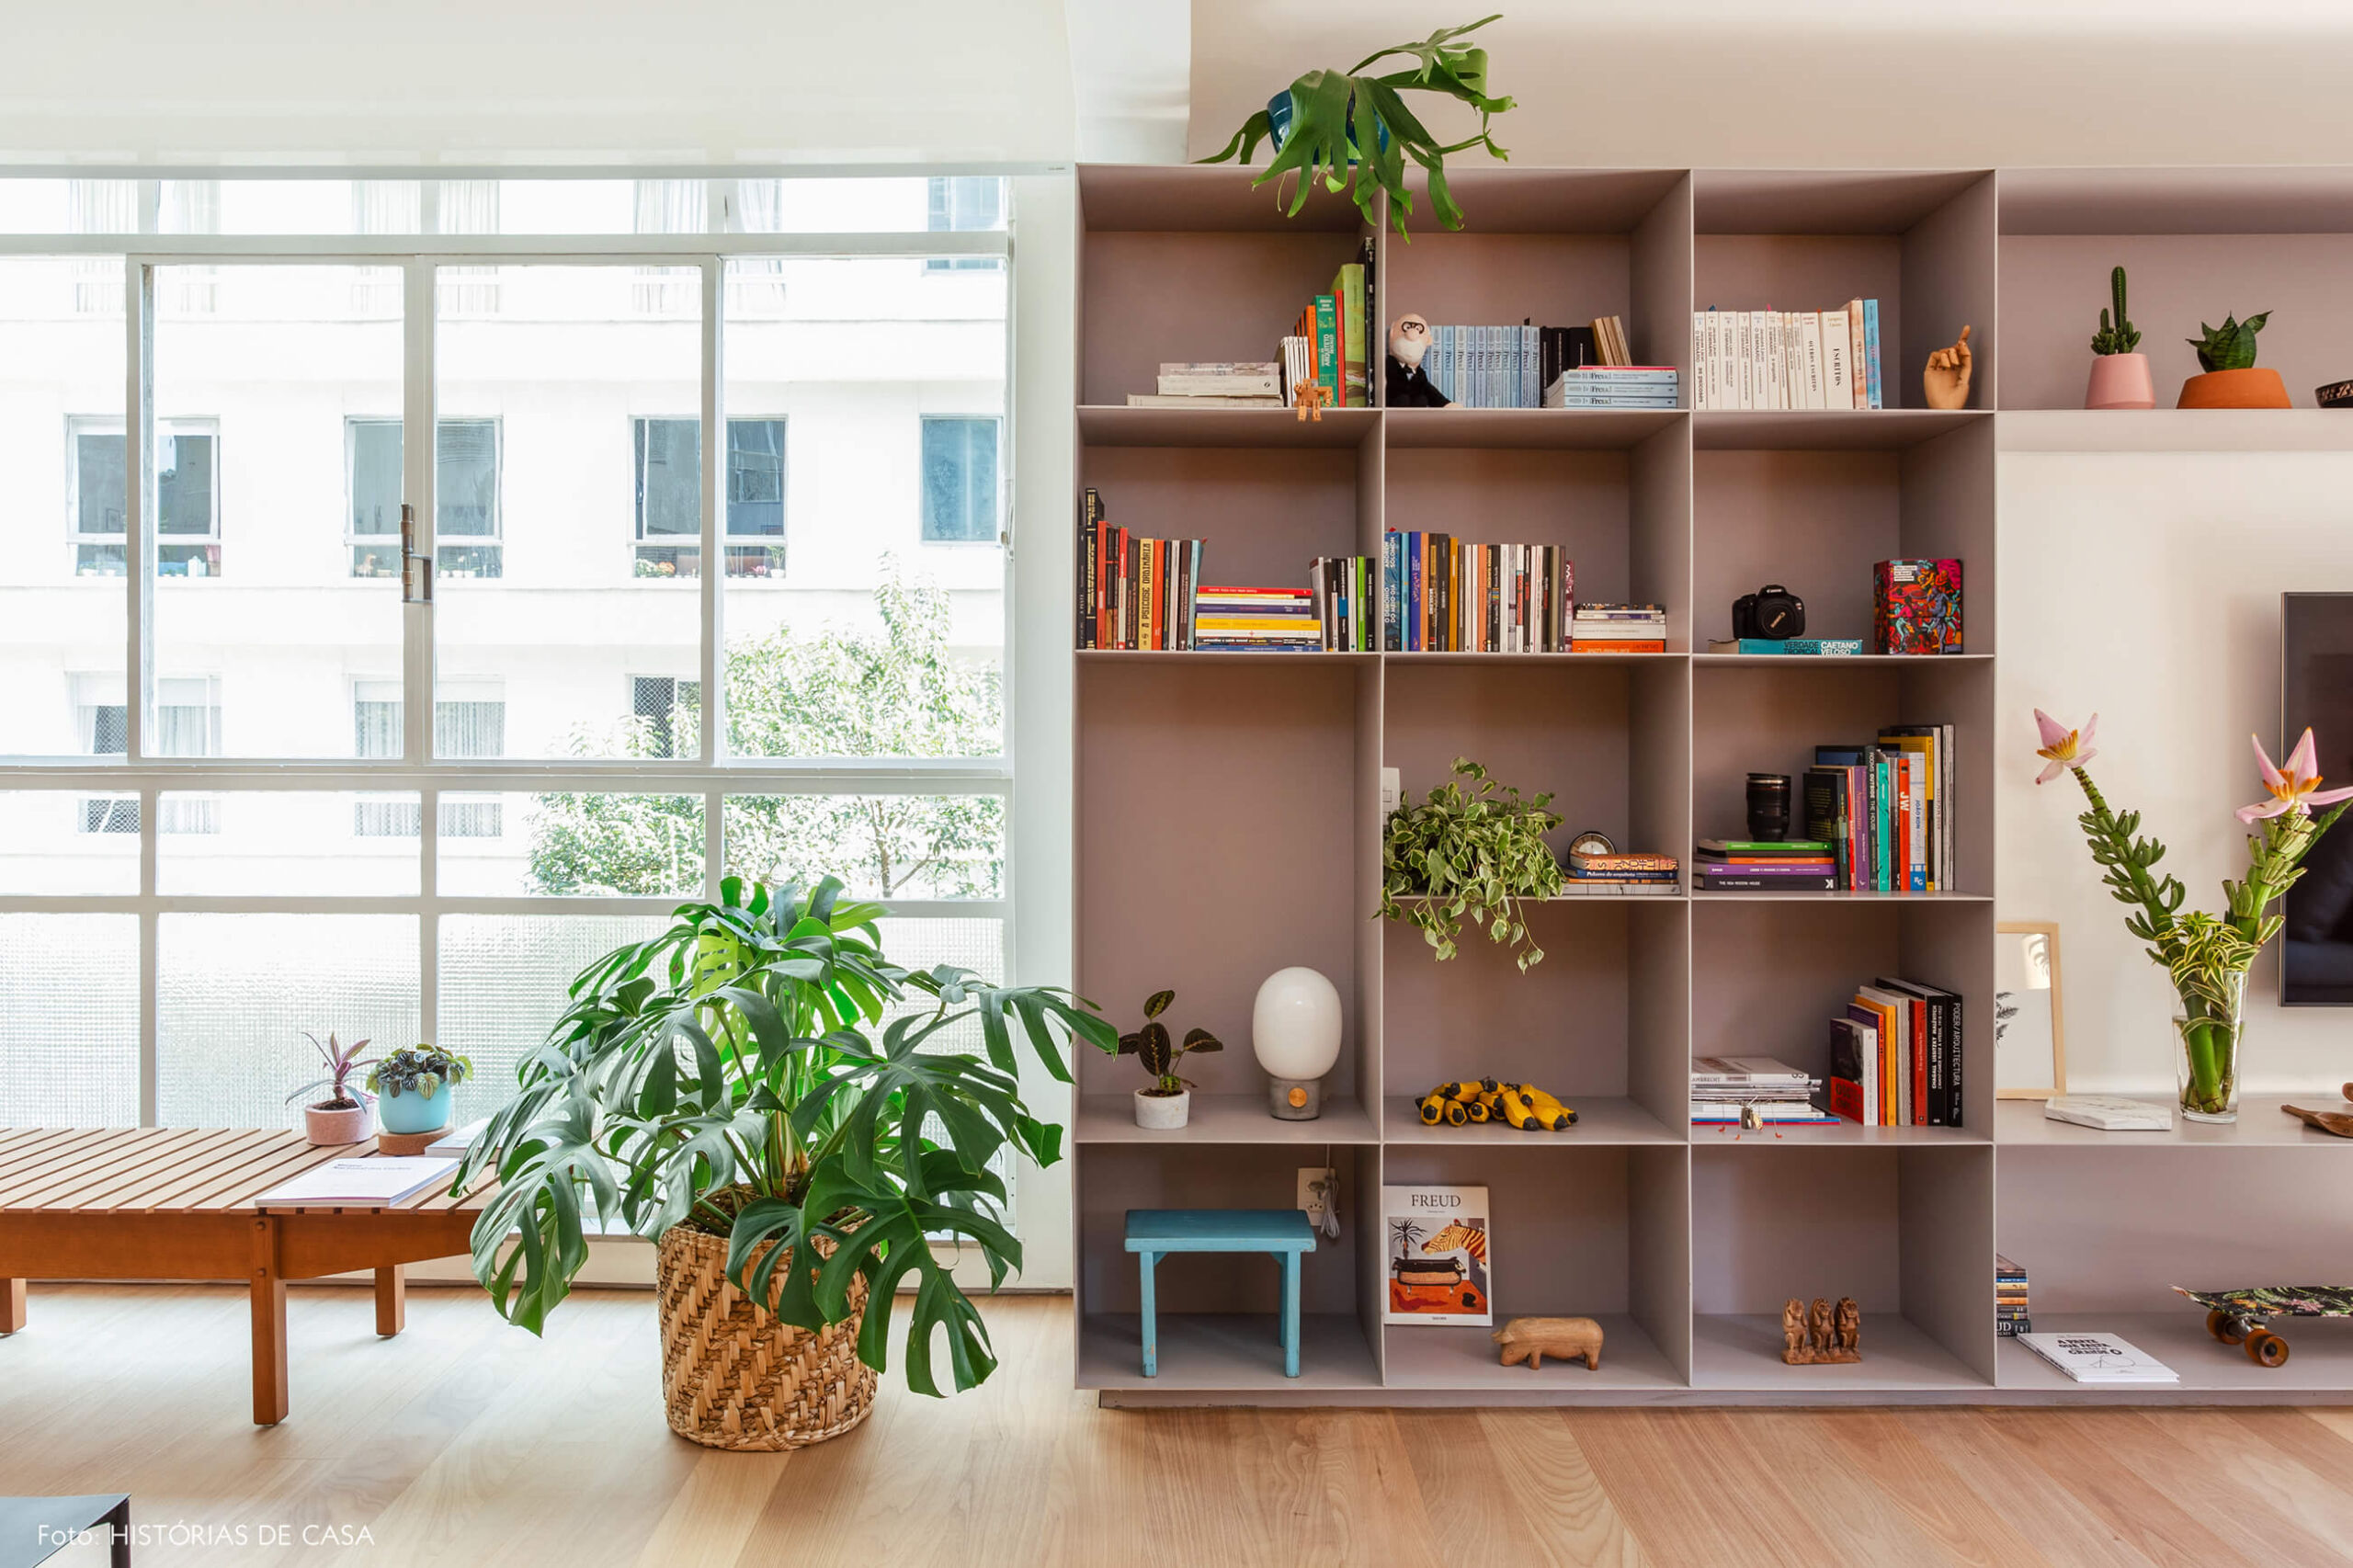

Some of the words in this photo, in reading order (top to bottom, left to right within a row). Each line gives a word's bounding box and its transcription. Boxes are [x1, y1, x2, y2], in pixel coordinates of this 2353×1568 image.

[1833, 347, 1841, 387] ESCRITOS
[1141, 543, 1152, 585] ORDINÁRIA
[1142, 586, 1151, 619] PSICOSE
[1390, 613, 1396, 623] DO
[1900, 791, 1909, 812] JW
[1952, 1002, 1961, 1086] PODER/ARQUITECTURA
[1411, 1194, 1461, 1208] FREUD
